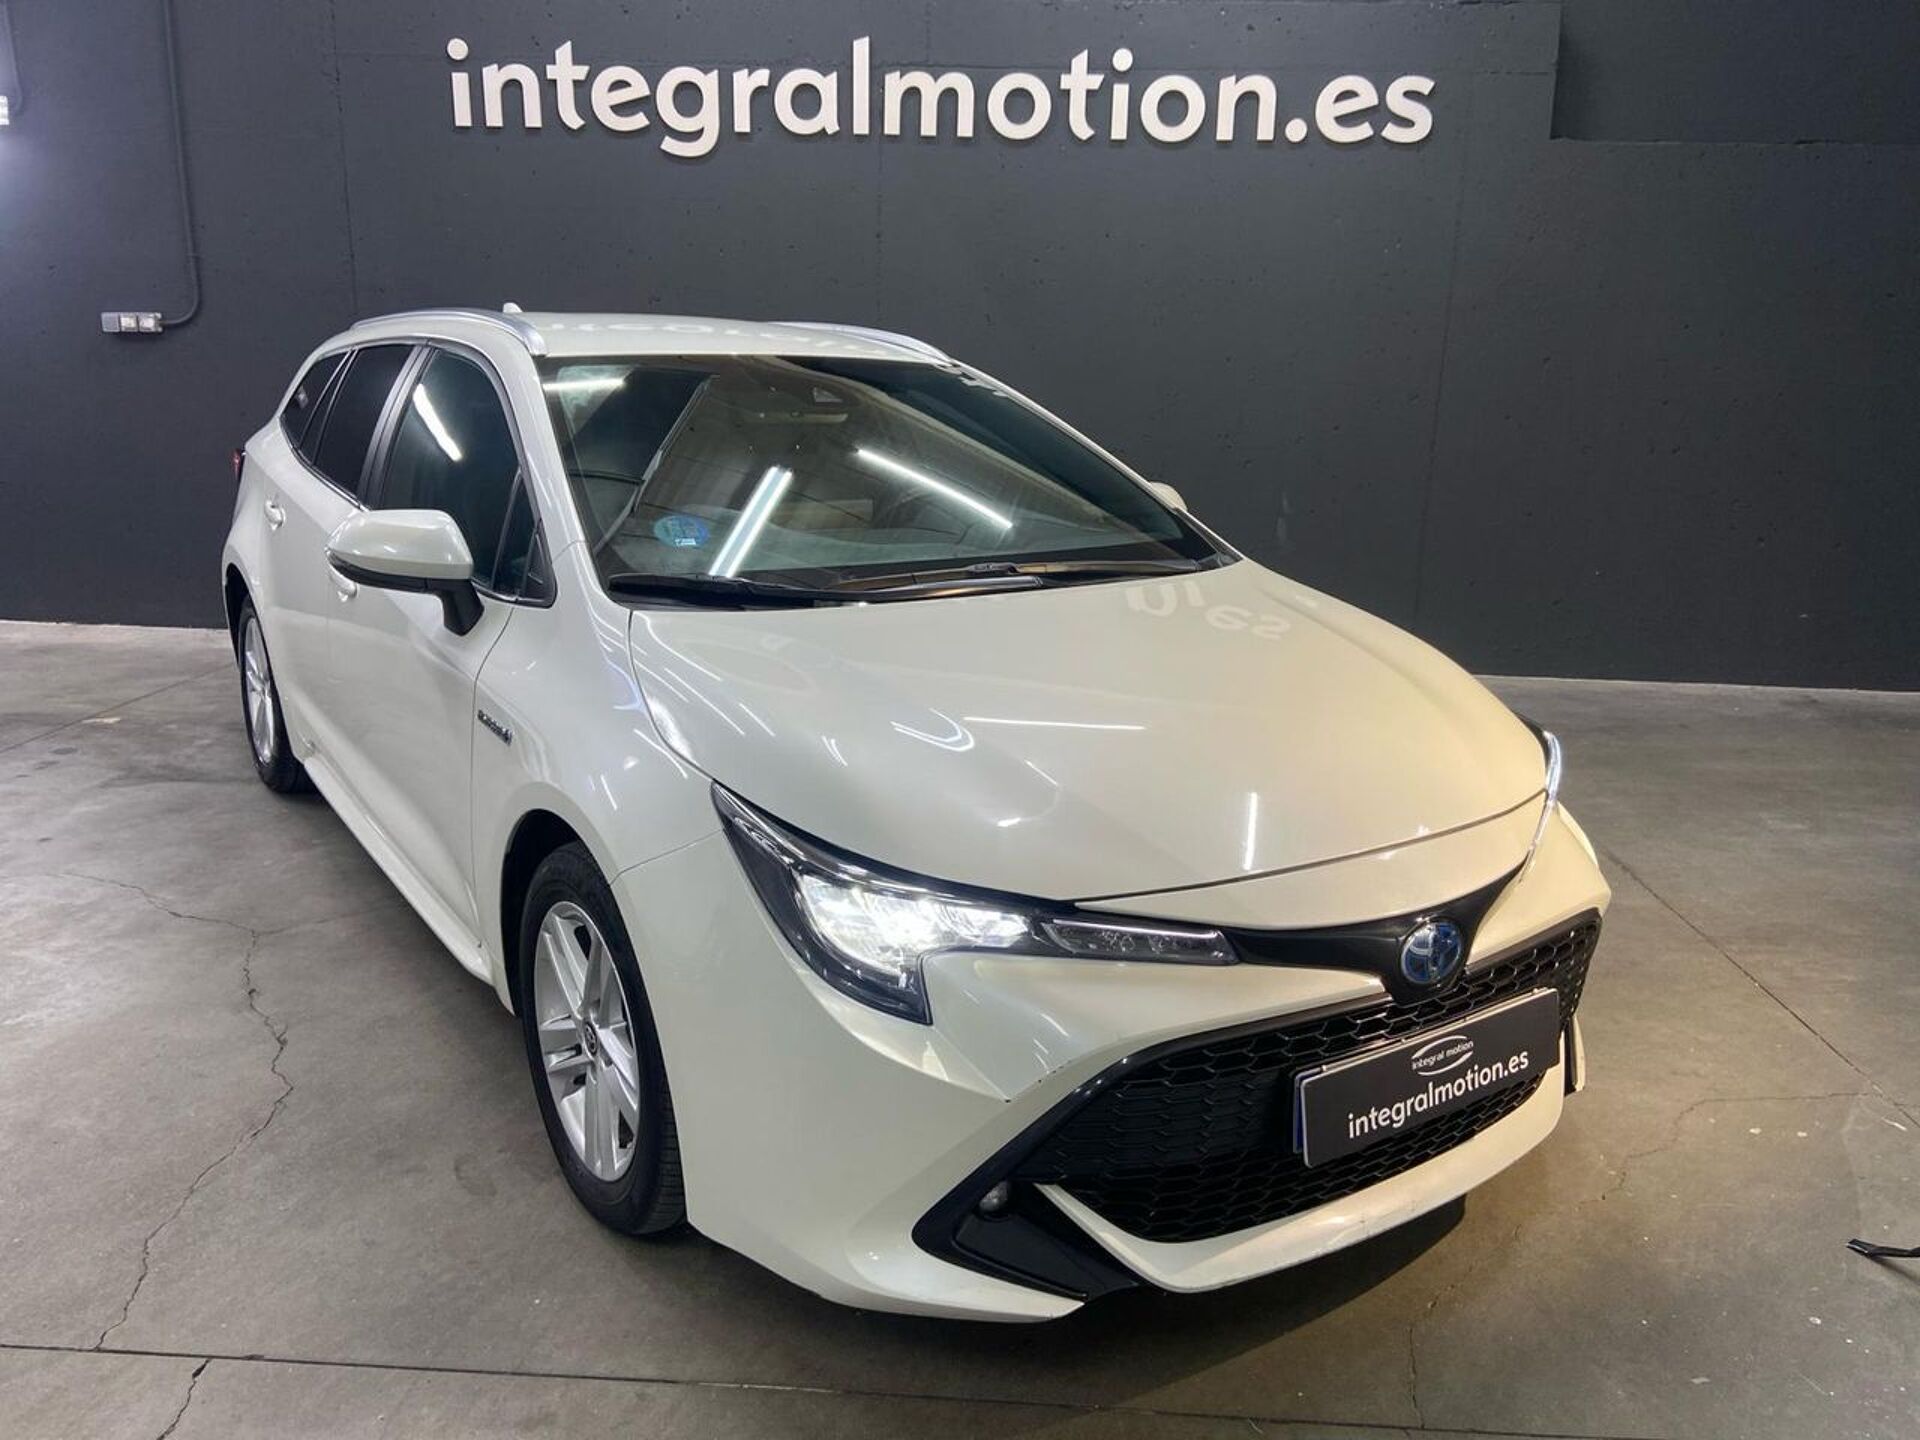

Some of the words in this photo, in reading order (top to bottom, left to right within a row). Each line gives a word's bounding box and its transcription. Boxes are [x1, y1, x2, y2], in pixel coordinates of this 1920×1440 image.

[446, 36, 1435, 157] integralmotion.es
[1348, 1051, 1529, 1138] integralmotion.es
[1412, 1051, 1445, 1070] integral
[1445, 1040, 1474, 1058] motion
